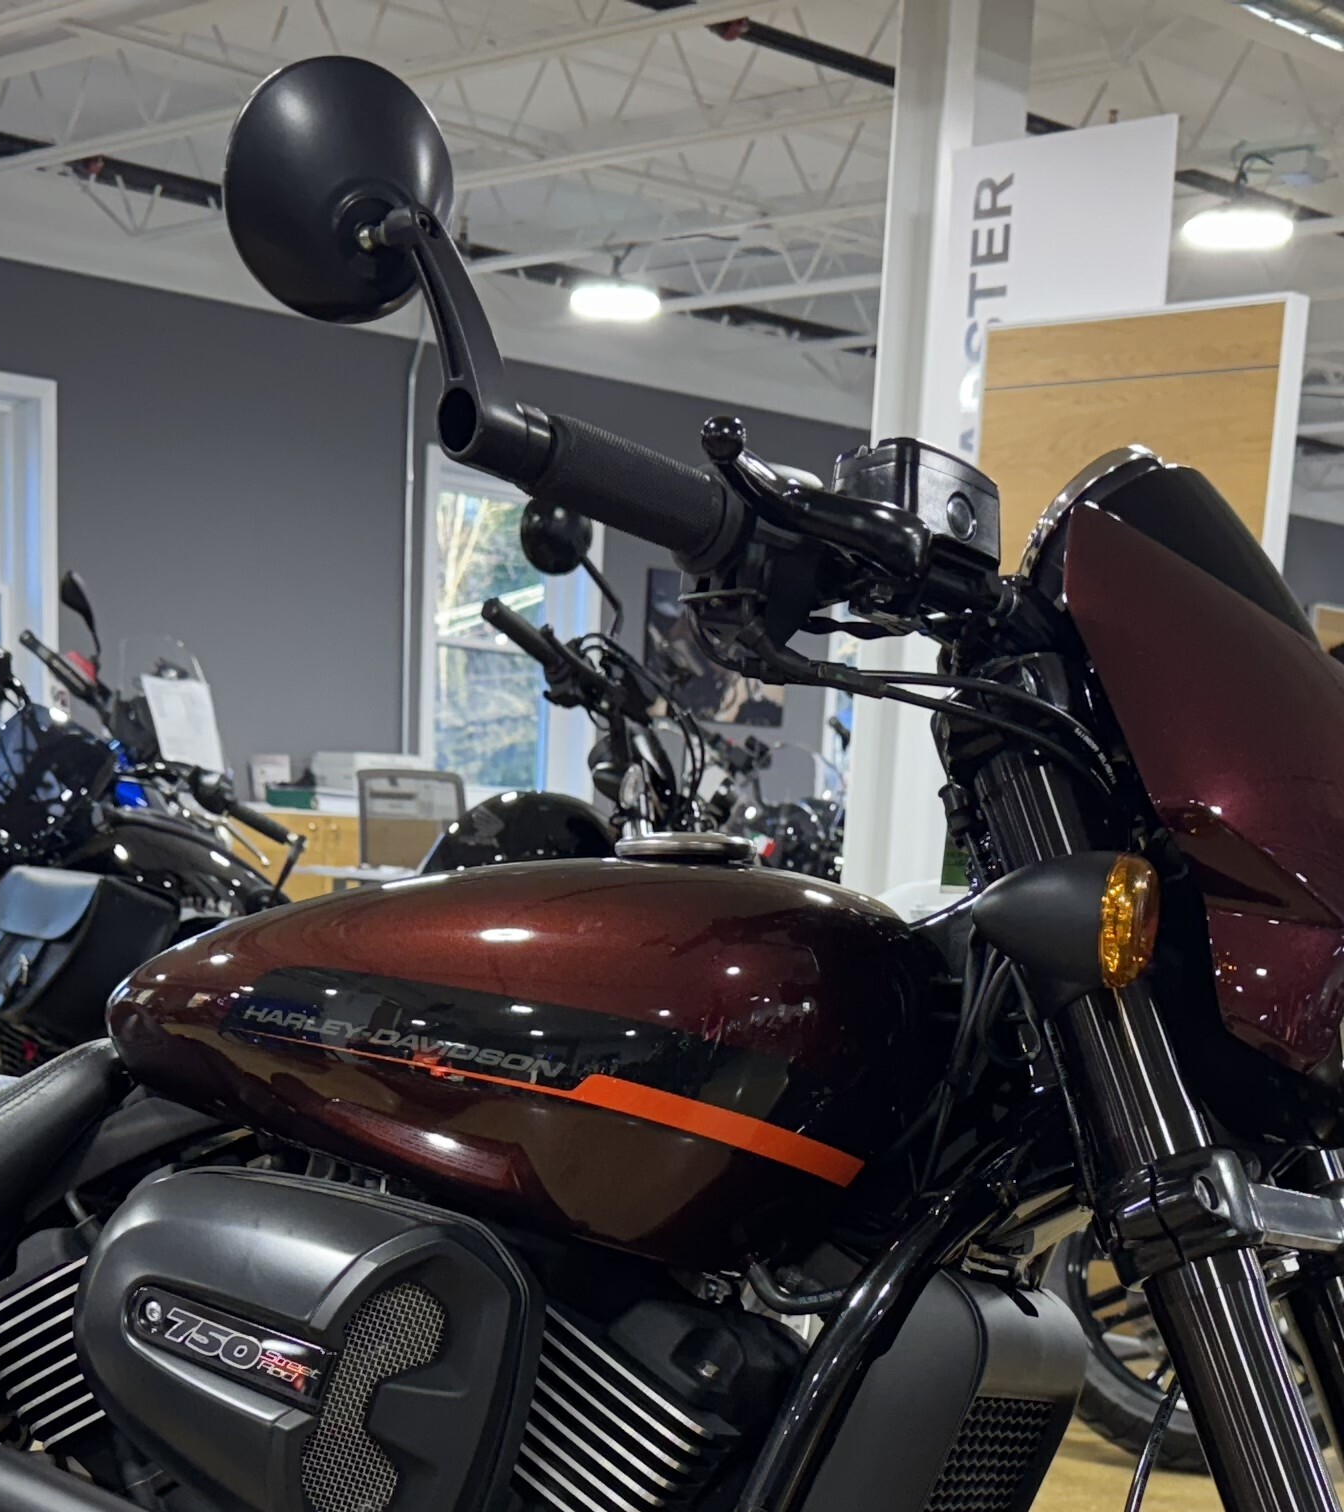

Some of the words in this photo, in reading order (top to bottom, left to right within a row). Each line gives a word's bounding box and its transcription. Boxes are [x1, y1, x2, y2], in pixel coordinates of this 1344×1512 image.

[243, 1004, 567, 1079] HARLEY-DAVIDSON
[164, 1307, 263, 1370] 750
[257, 1361, 299, 1383] Rod
[260, 1350, 323, 1380] Street
